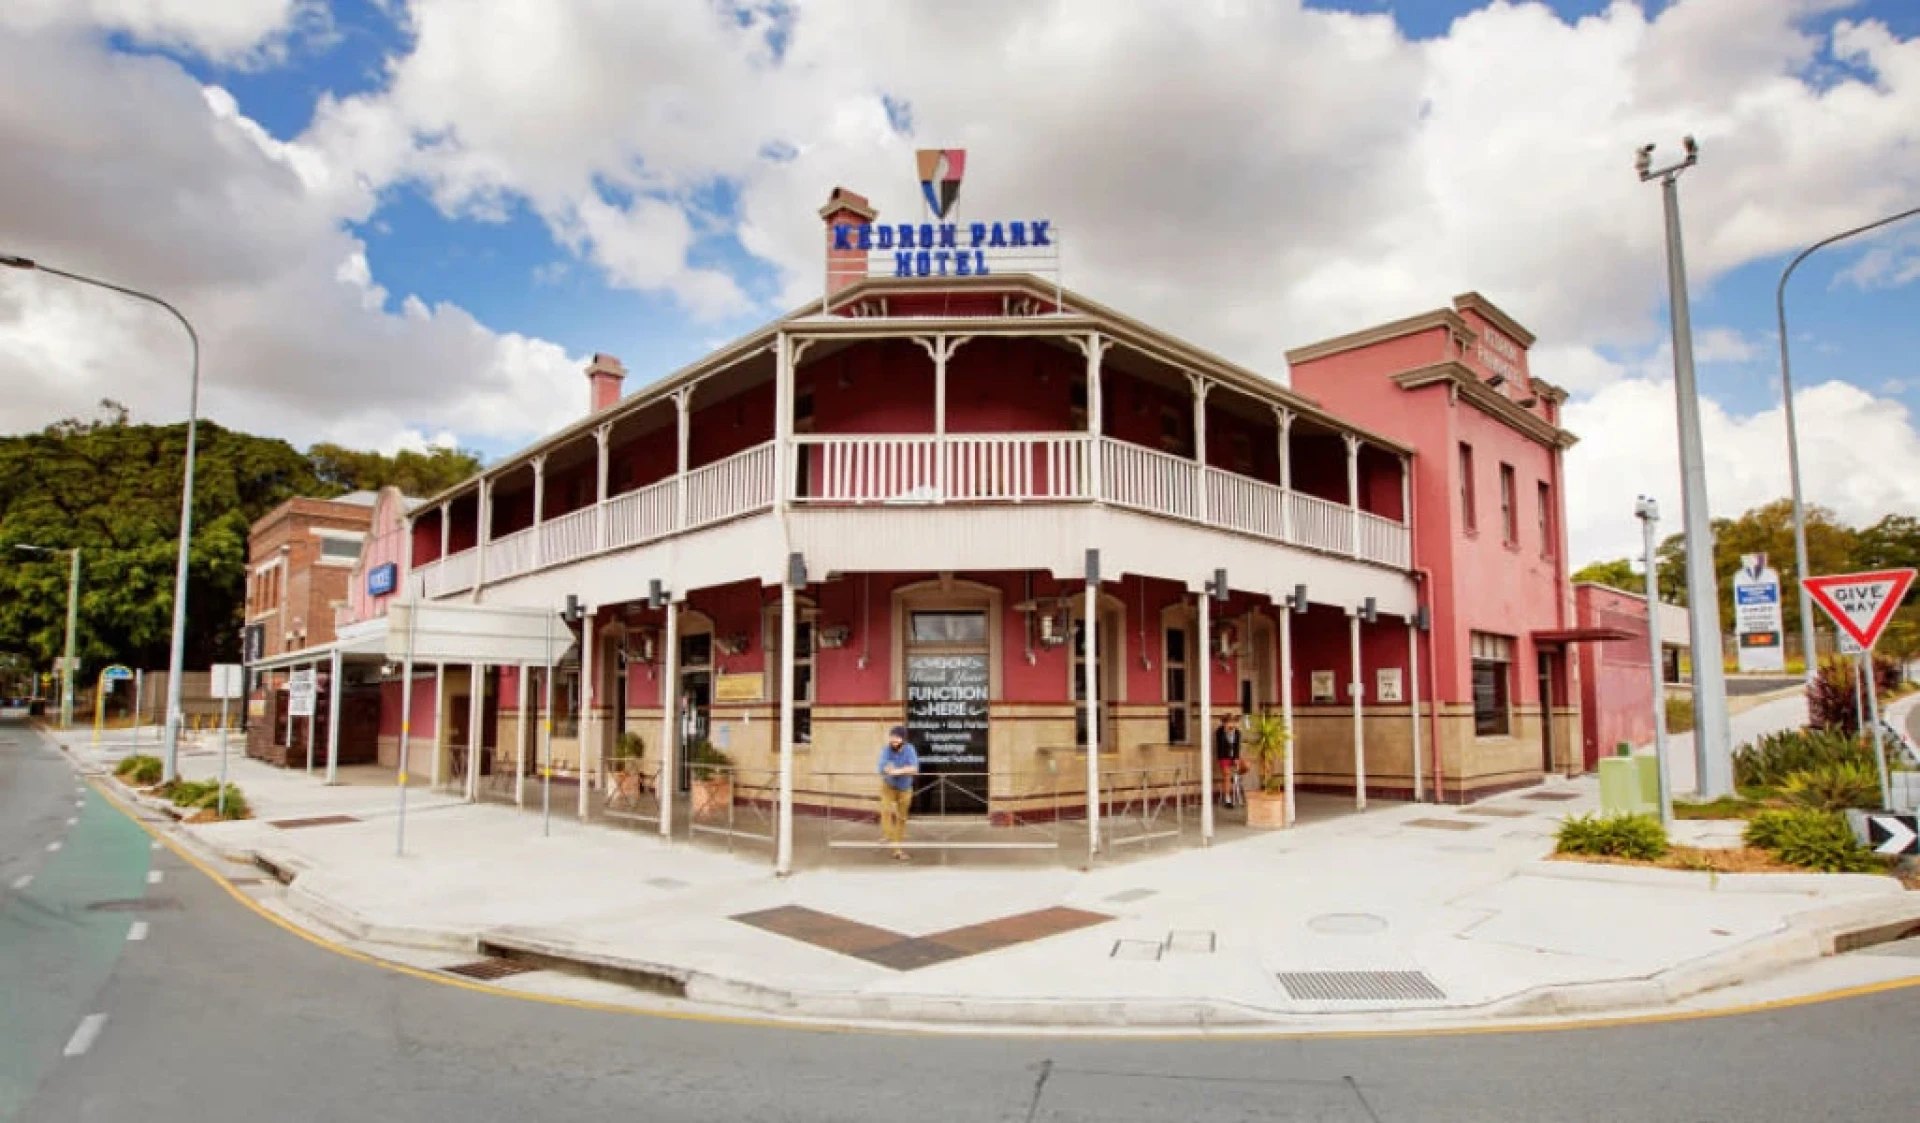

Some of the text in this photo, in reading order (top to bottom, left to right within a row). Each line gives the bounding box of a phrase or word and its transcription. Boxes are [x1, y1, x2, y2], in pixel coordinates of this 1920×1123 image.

[834, 220, 1051, 249] KEDRON PARK
[895, 250, 989, 277] HOTEL
[1835, 584, 1884, 601] GIVE
[1844, 601, 1876, 612] WAY
[908, 686, 988, 700] FUNCTION
[928, 701, 966, 716] HERE
